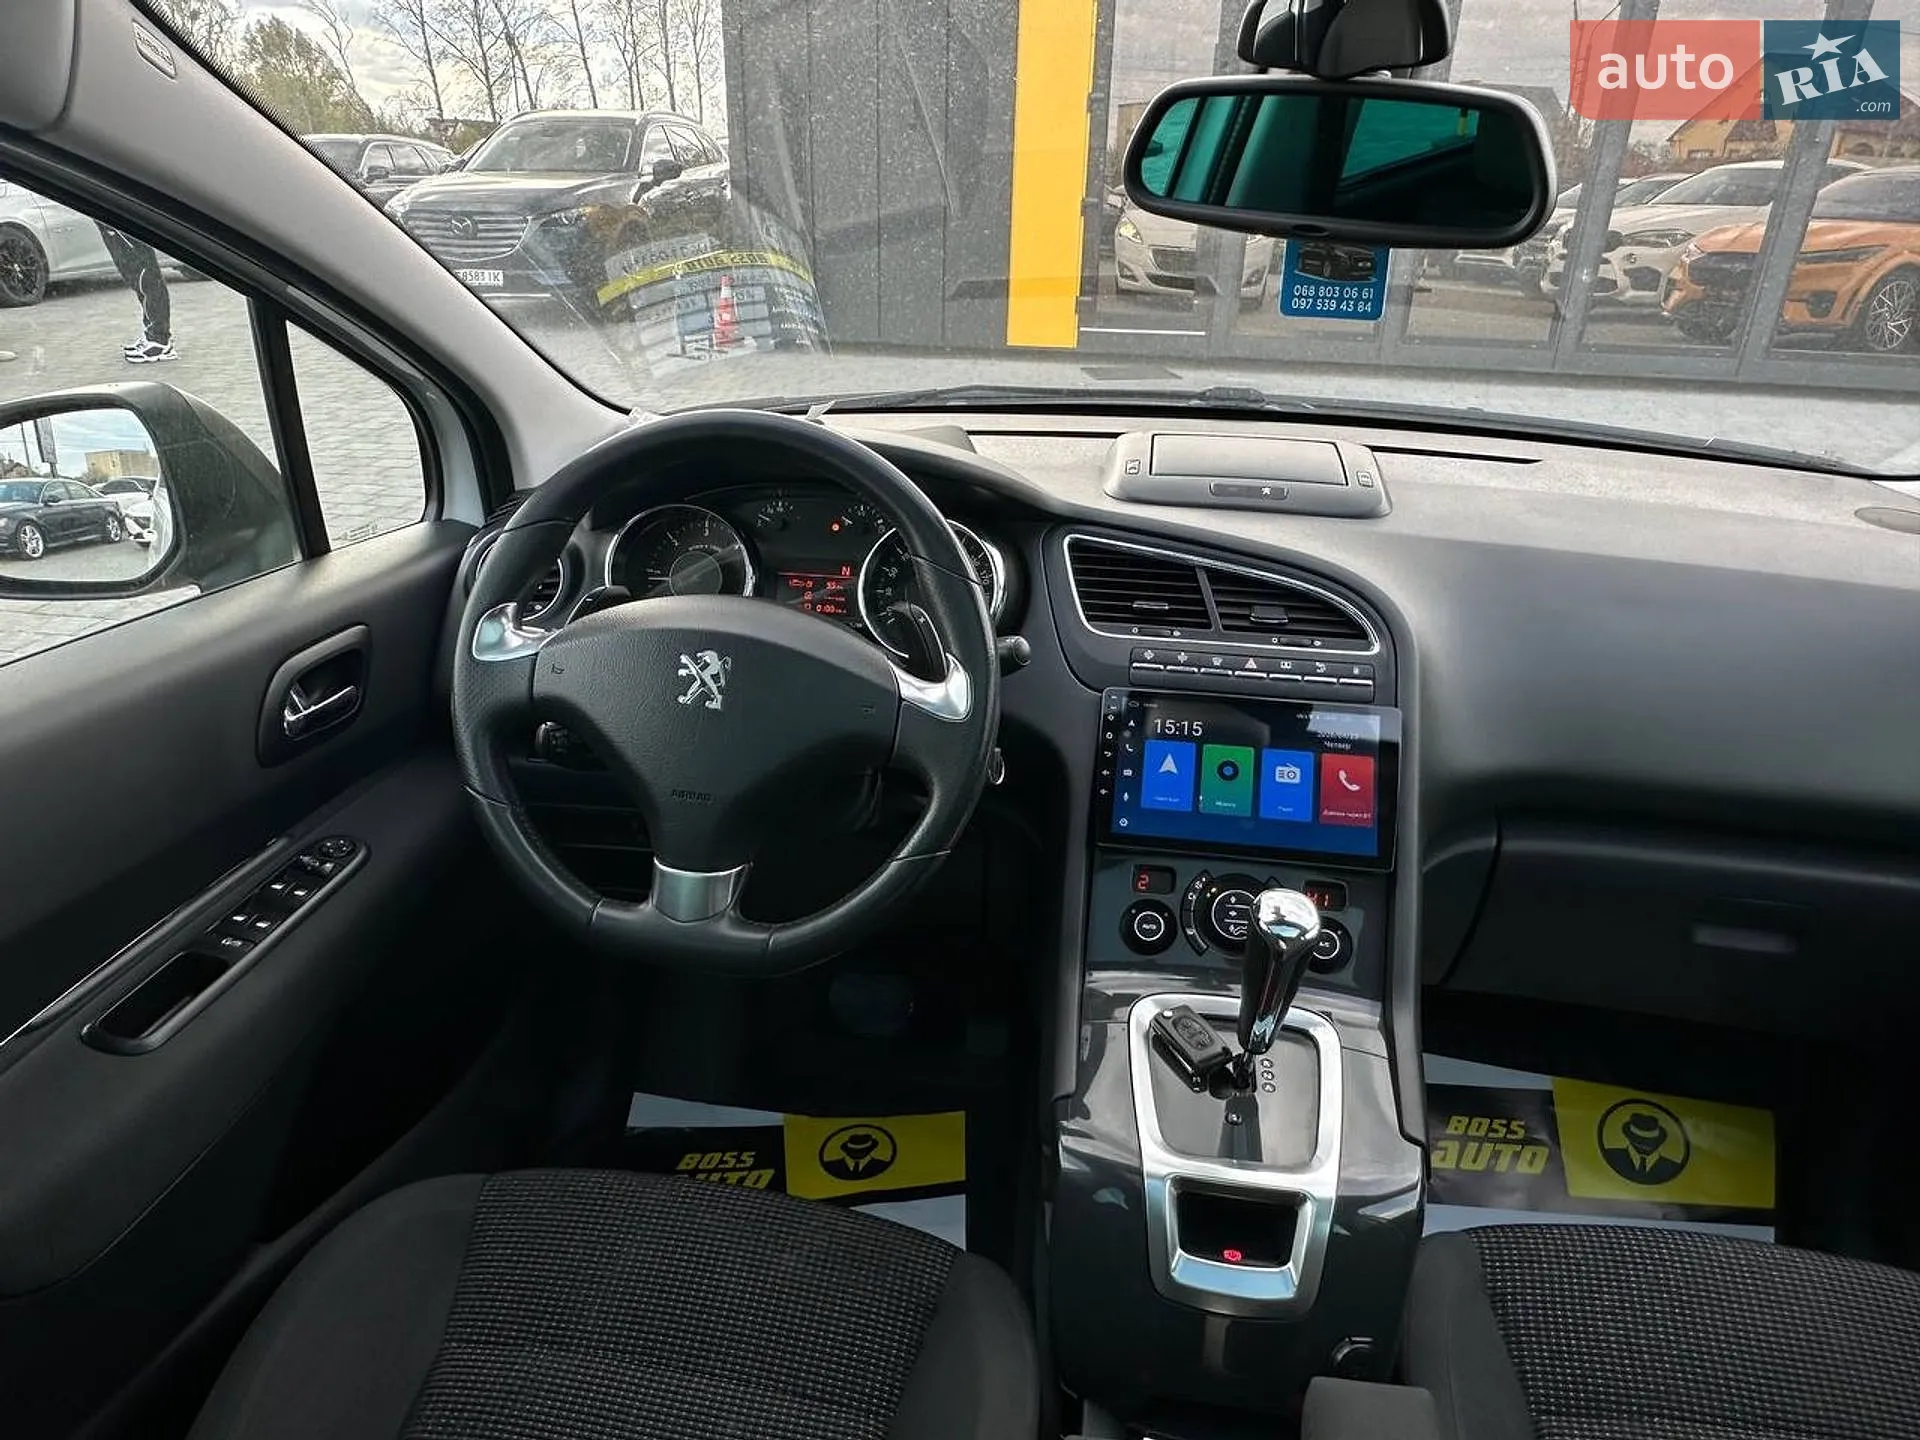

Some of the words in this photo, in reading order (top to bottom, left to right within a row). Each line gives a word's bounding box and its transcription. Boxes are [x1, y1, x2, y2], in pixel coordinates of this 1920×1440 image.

[1343, 287, 1358, 299] 06
[1291, 298, 1313, 310] 097
[1316, 299, 1337, 311] 539
[1340, 300, 1354, 312] 43
[1357, 301, 1372, 313] 84
[841, 566, 850, 575] N
[1153, 719, 1203, 737] 15:15
[1138, 874, 1149, 890] 2
[1445, 1115, 1526, 1139] BOSS
[676, 1151, 757, 1170] BOSS
[1431, 1140, 1550, 1175] AUTO
